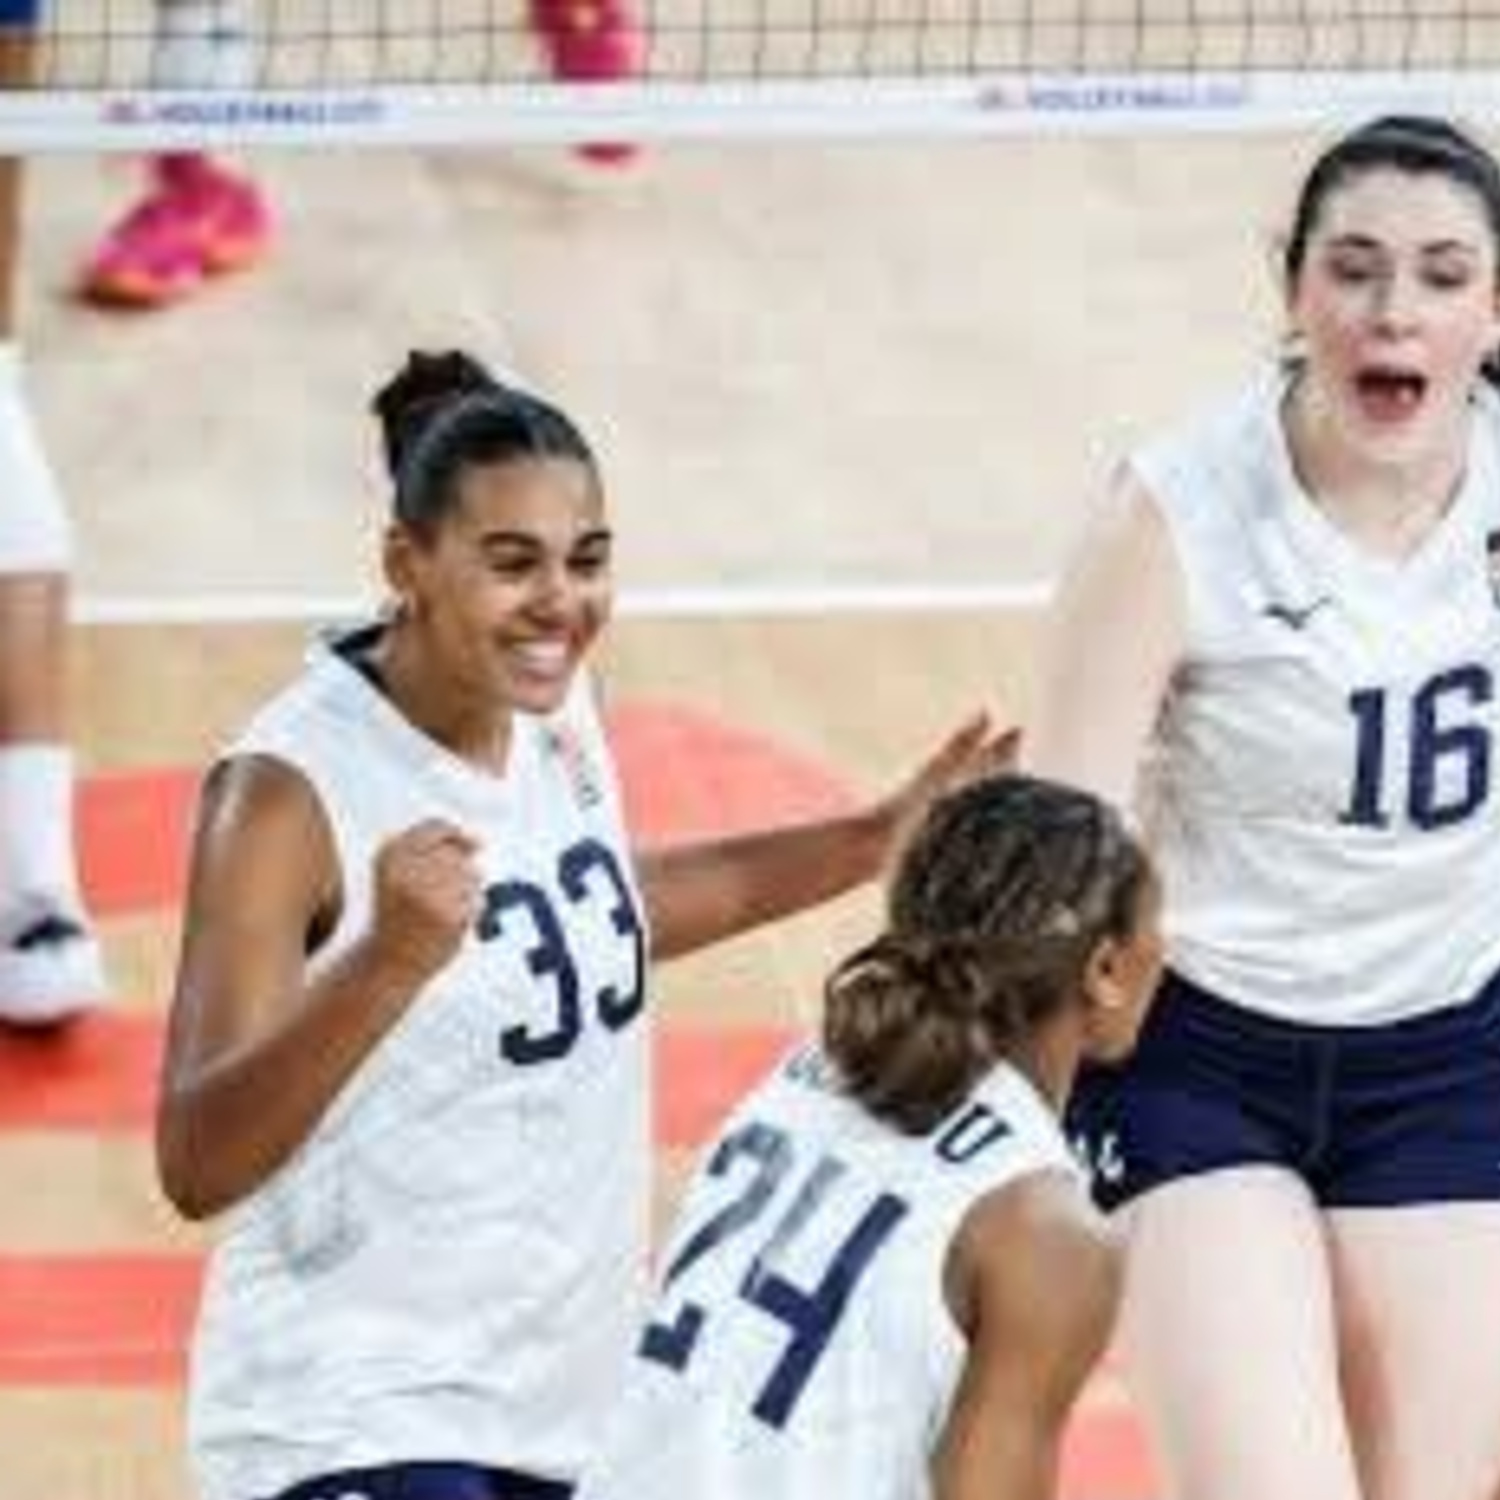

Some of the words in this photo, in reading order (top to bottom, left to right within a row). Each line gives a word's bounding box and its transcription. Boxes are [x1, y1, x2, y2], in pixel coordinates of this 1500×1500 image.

[1337, 663, 1494, 831] 16
[477, 838, 645, 1065] 33
[636, 1121, 909, 1431] 24
